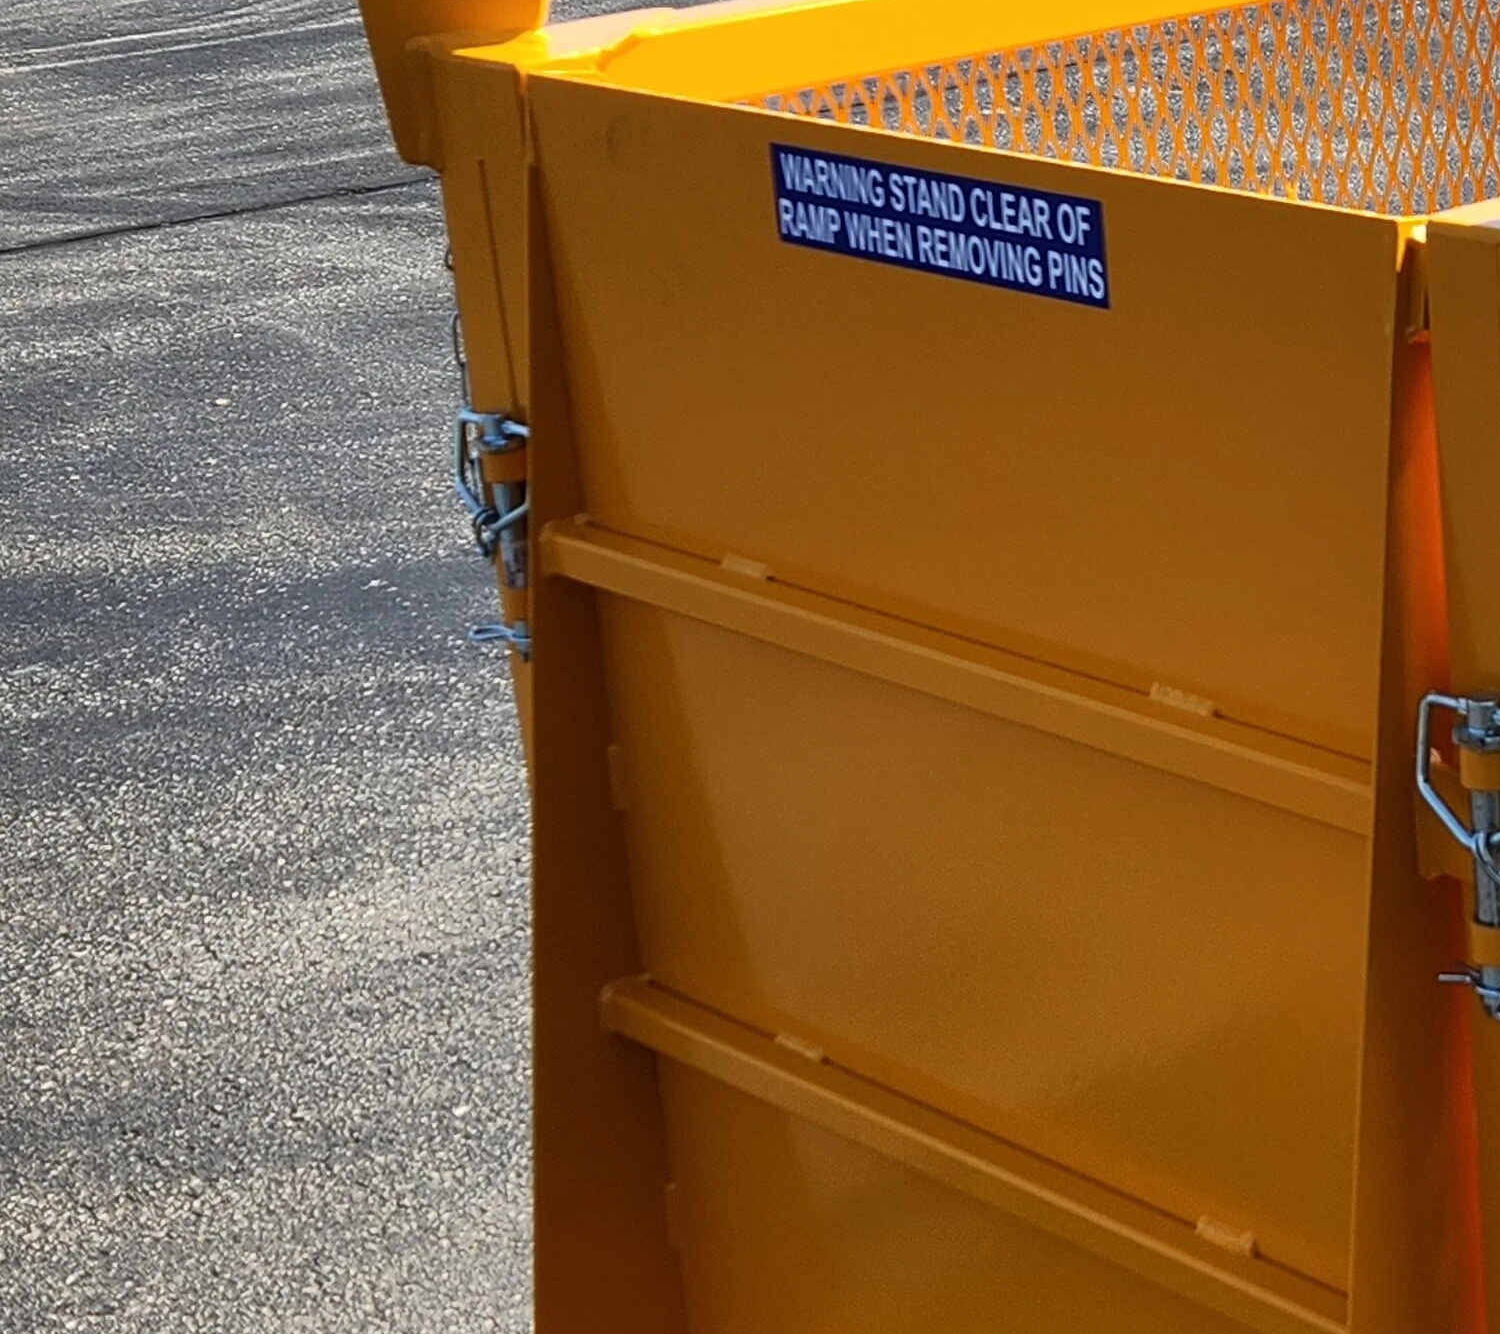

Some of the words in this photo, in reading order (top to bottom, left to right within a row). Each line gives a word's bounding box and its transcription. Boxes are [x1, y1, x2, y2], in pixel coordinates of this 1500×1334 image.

[778, 197, 841, 244] RAMP
[843, 211, 914, 261] WHEN
[916, 225, 1043, 287] REMOVING
[1047, 251, 1105, 300] PINS
[780, 152, 885, 208] WARNING
[888, 173, 965, 221] STAND
[970, 188, 1053, 240] CLEAR
[1056, 203, 1091, 247] OF
